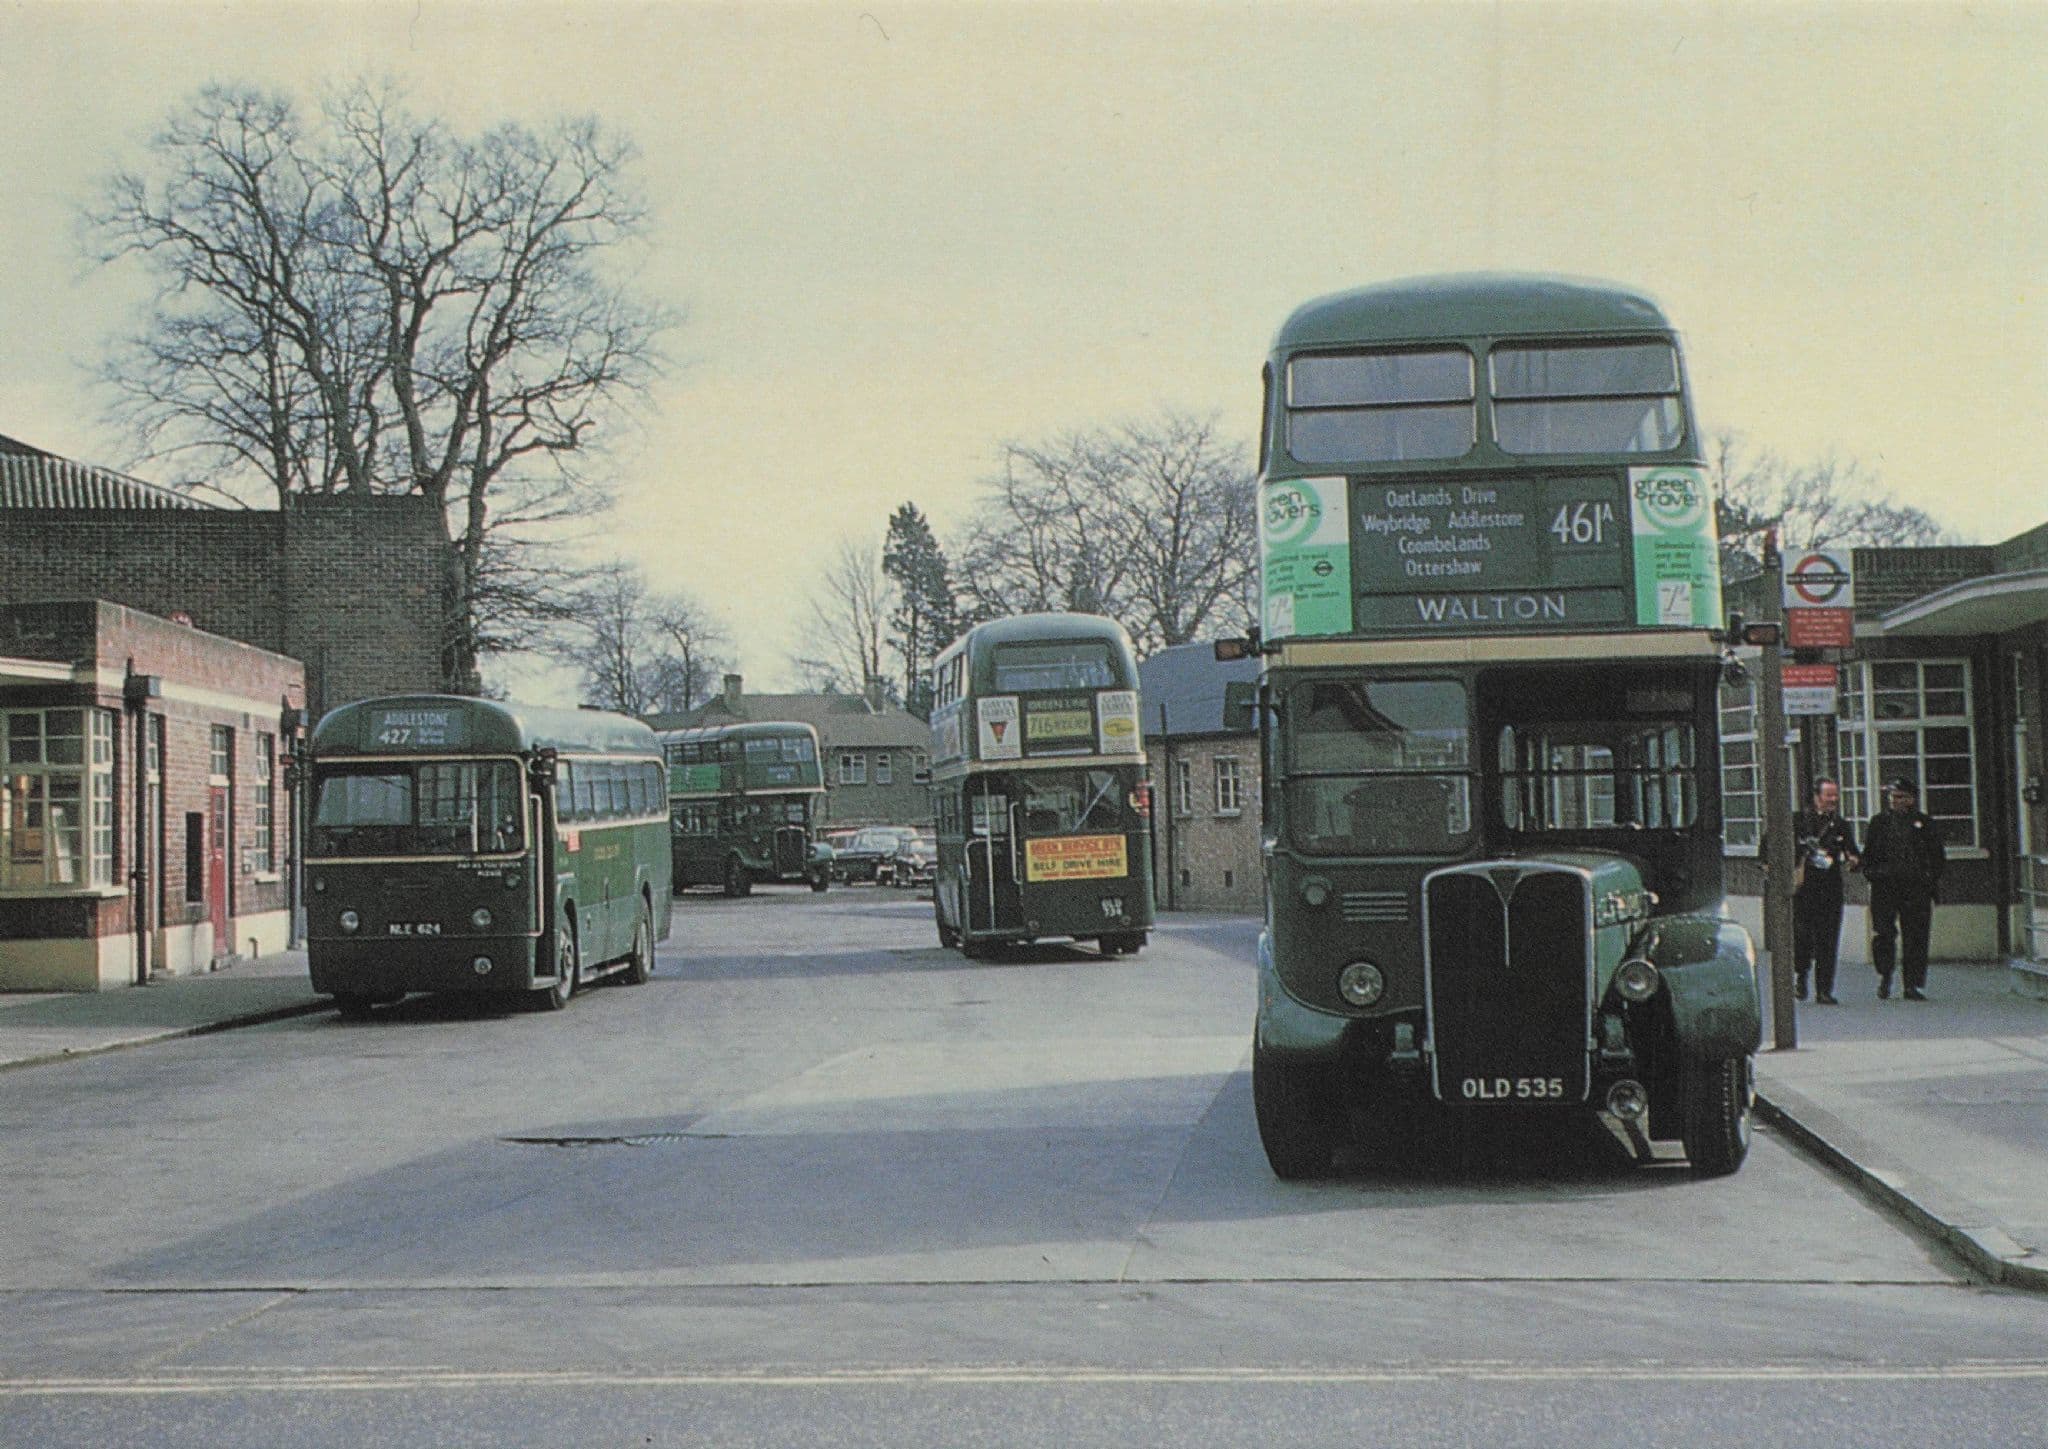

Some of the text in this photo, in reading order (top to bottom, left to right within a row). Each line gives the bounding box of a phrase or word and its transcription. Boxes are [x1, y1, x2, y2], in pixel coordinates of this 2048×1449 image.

[1387, 487, 1497, 507] Oatlands Drive
[1634, 479, 1696, 499] green
[1361, 511, 1524, 535] Weybridge Addlestone
[1399, 534, 1491, 553] Coombelands
[1405, 558, 1482, 576] Ottershaw
[1417, 596, 1565, 621] WALTON
[379, 728, 411, 745] 427
[1463, 1078, 1563, 1098] OLD 535
